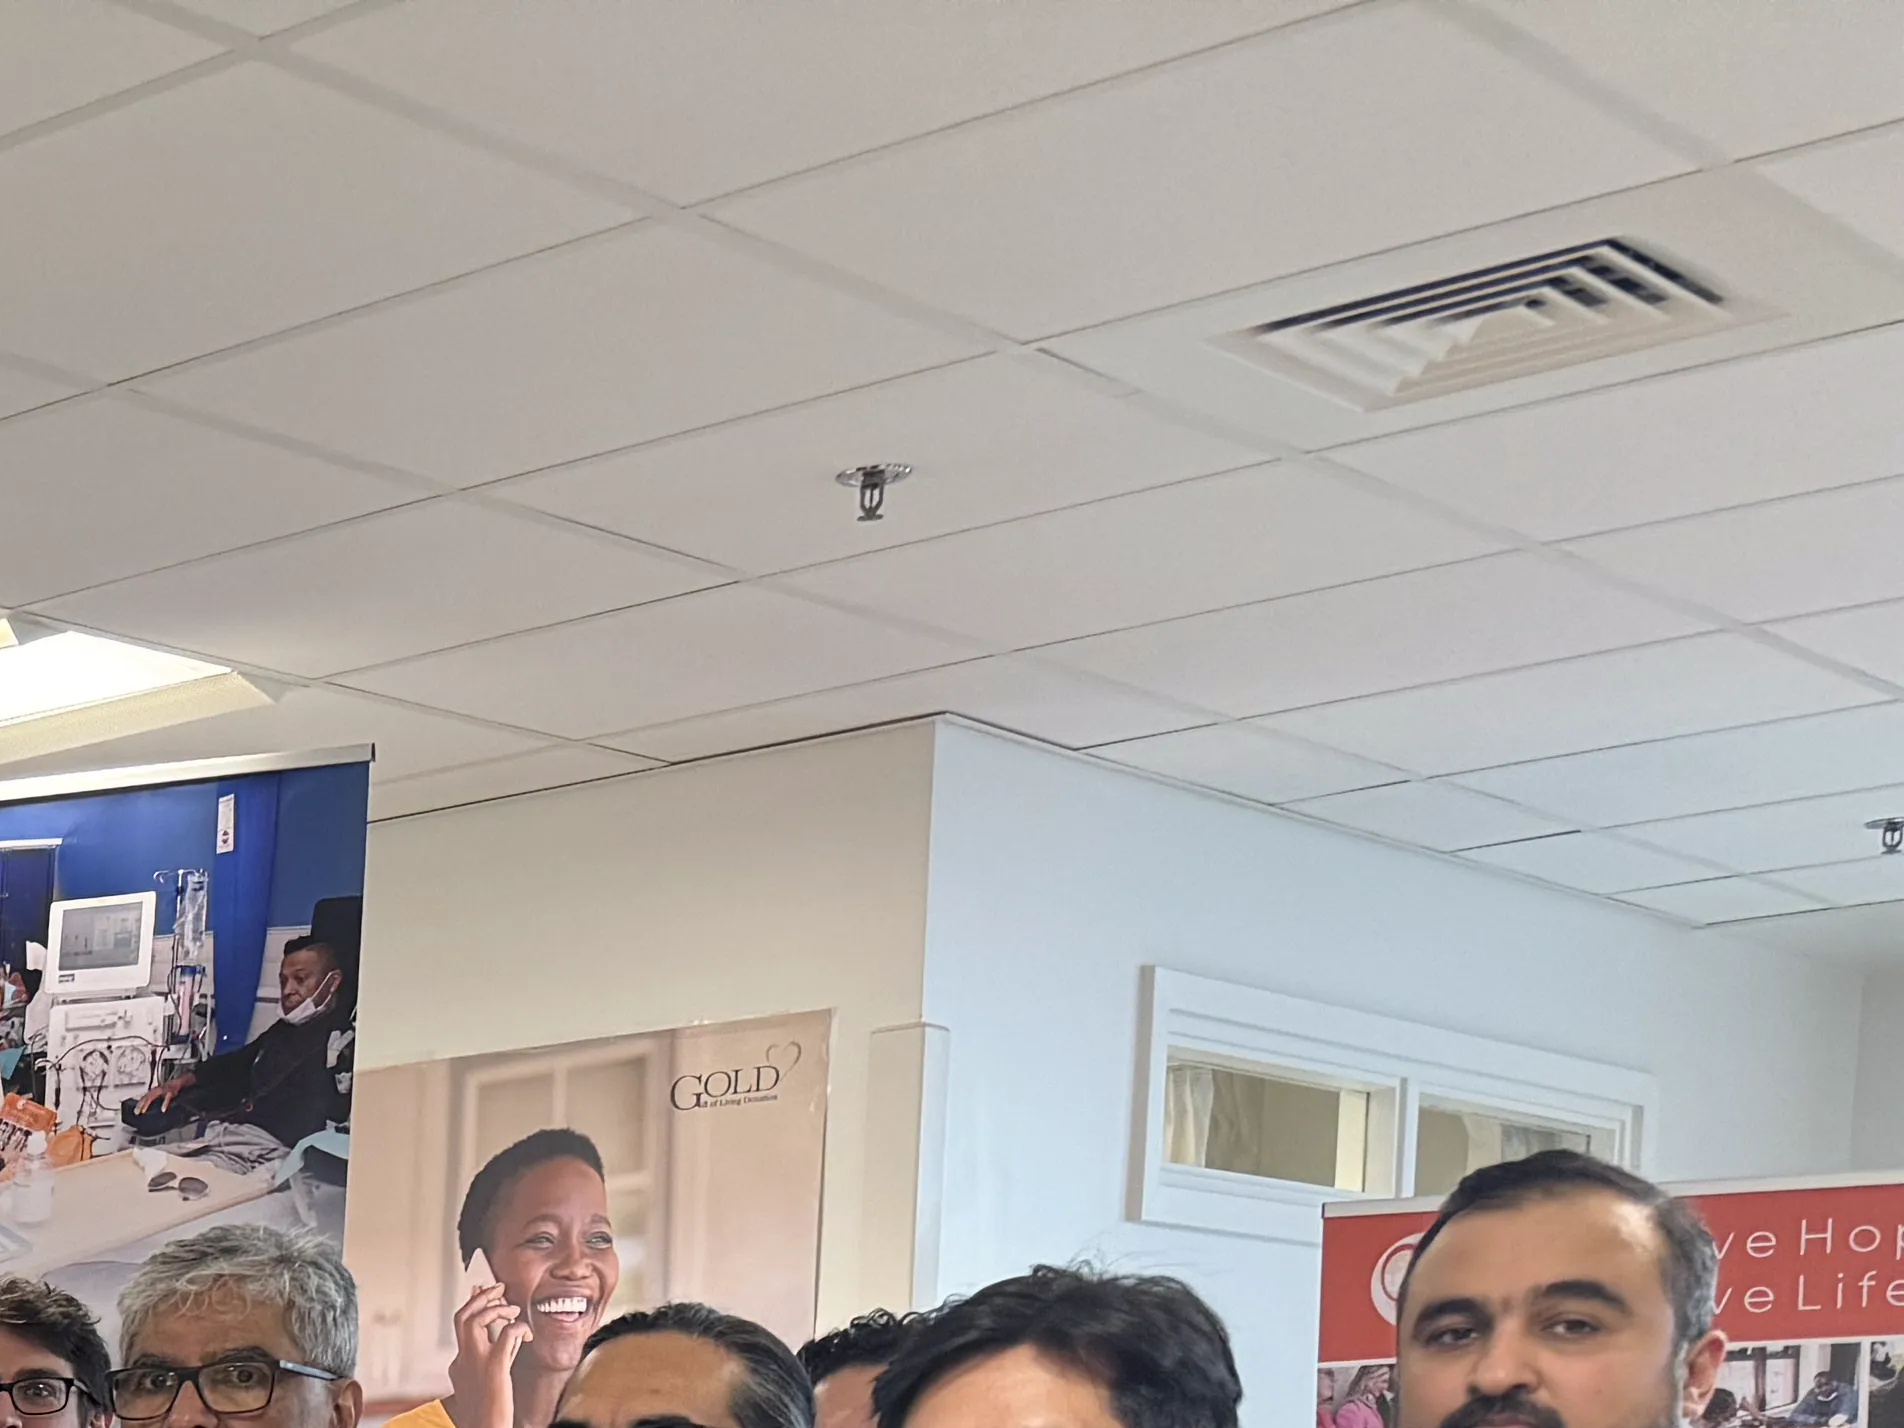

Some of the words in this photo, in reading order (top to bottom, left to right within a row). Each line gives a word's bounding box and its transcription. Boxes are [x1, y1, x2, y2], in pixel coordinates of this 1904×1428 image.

[670, 1065, 780, 1111] GOLD
[1712, 1231, 1777, 1261] ve
[1711, 1286, 1775, 1315] ve
